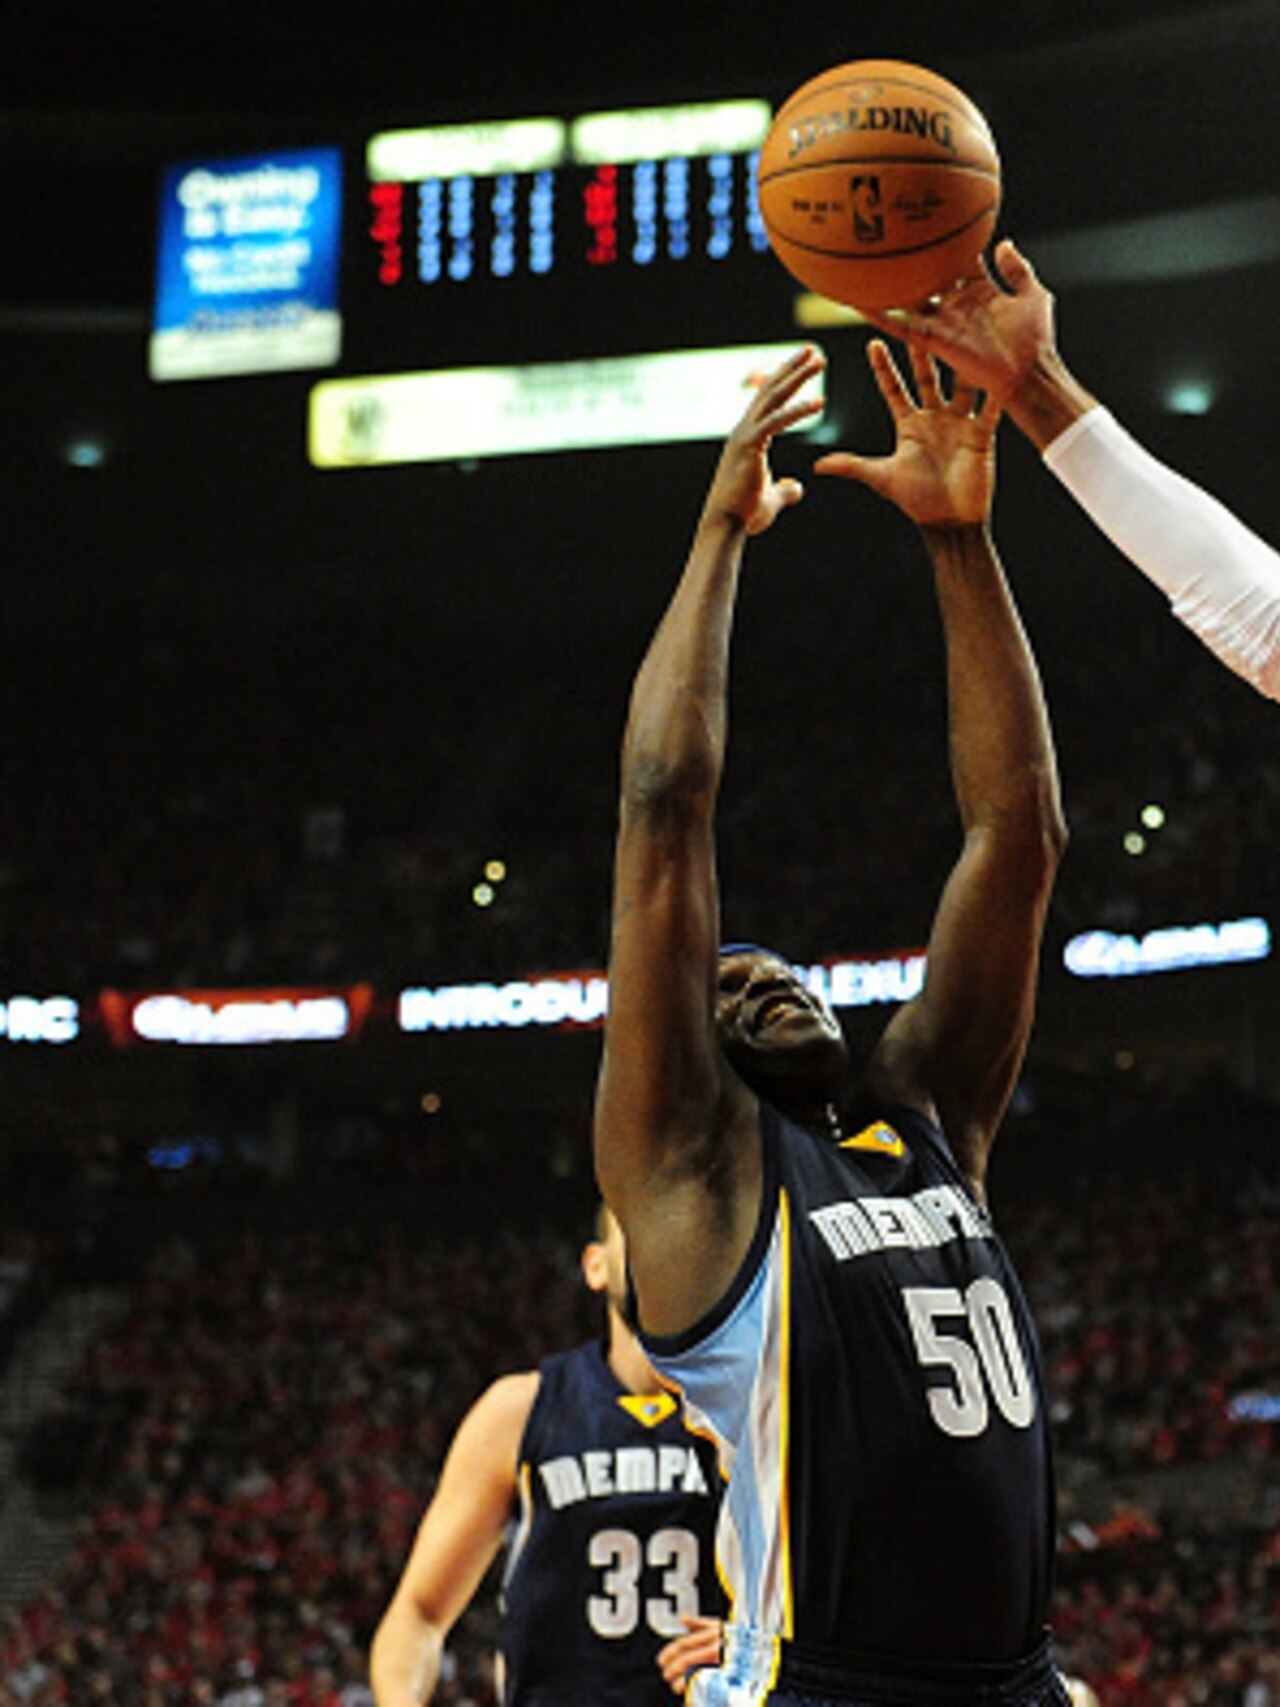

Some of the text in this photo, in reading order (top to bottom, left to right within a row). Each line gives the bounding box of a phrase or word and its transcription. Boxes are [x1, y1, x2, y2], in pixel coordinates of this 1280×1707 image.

[789, 107, 956, 159] SPALDING
[901, 1276, 1036, 1437] 50
[586, 1528, 700, 1639] 33
